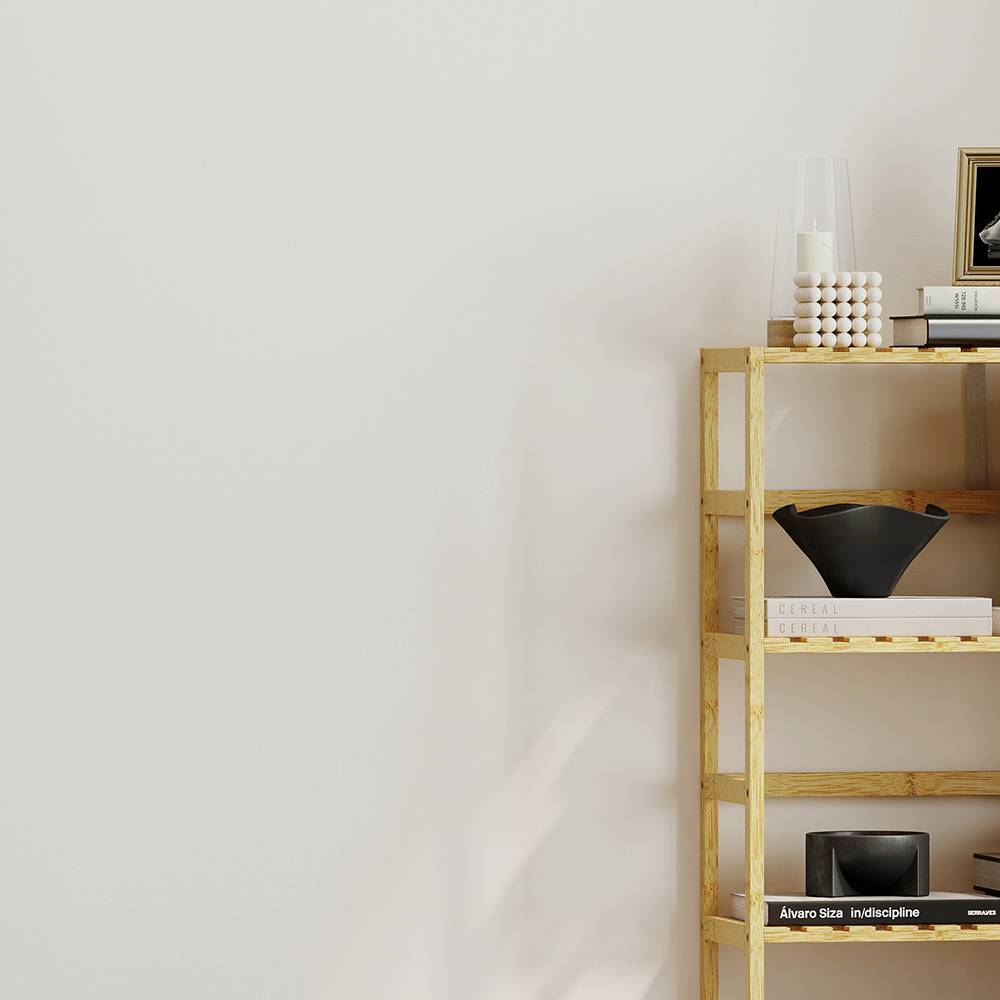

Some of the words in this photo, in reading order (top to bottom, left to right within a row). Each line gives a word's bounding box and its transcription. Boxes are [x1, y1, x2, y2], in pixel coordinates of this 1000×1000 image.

[778, 603, 839, 615] CEREAL
[778, 622, 839, 634] CEREAL
[780, 906, 817, 919] Álvaro
[819, 908, 844, 919] Siza
[850, 907, 920, 920] in/discipline
